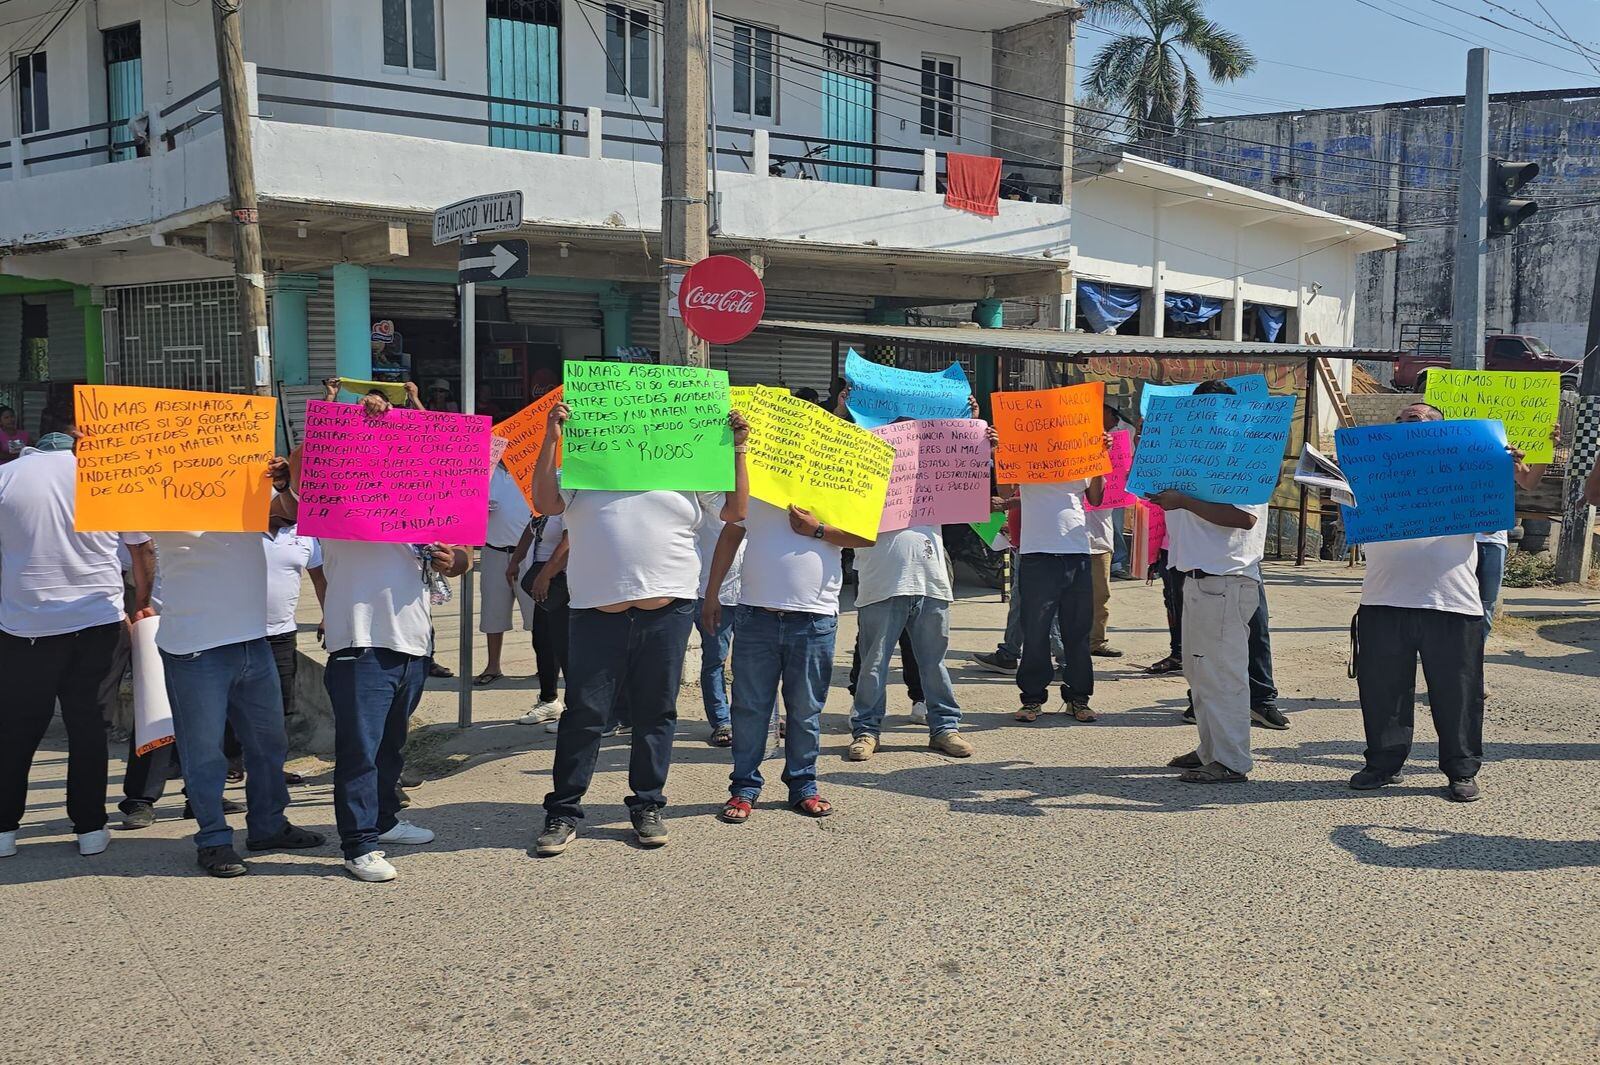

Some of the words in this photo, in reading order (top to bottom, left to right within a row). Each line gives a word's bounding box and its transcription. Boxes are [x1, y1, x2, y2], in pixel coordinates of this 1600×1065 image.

[437, 205, 478, 237] FRANCISCO
[482, 200, 514, 224] VILLA
[567, 364, 584, 378] NO
[589, 365, 621, 378] MAS
[567, 380, 631, 392] INOCENTES
[635, 381, 646, 390] SI
[668, 380, 710, 389] GUERRA
[713, 381, 725, 389] ES
[1429, 372, 1493, 387] EXIGIMOS
[1499, 375, 1517, 389] TU
[566, 396, 608, 407] ENTRE
[614, 393, 667, 407] USTEDES
[674, 391, 727, 402] ACABENSE
[756, 386, 773, 399] LOS
[1478, 392, 1516, 407] NARCO
[114, 402, 147, 417] MAS
[154, 399, 233, 412] ASESINATOS
[244, 399, 253, 411] A
[308, 403, 328, 414] LOS
[1222, 397, 1244, 409] DEL
[623, 410, 628, 422] Y
[631, 410, 646, 419] NO
[650, 406, 687, 417] MATEN
[695, 404, 720, 415] MAS
[1146, 412, 1174, 423] ORTE
[1187, 411, 1218, 422] EXIGE
[1225, 412, 1237, 422] LA
[1487, 407, 1525, 421] ESTAS
[80, 419, 150, 436] INOCENTES
[157, 418, 169, 428] SI
[254, 411, 270, 420] ES
[307, 416, 359, 427] CONTRAS
[1014, 412, 1091, 432] GOBERNADORA
[79, 437, 125, 451] ENTRE
[130, 429, 189, 445] USTEDES
[197, 421, 261, 435] ACABENSE
[306, 430, 354, 440] CONTRAS
[380, 433, 399, 441] LOS
[450, 434, 470, 442] LOS
[565, 424, 636, 438] INDEFENSOS
[644, 420, 683, 436] PSEUDO
[1171, 425, 1185, 435] DE
[1191, 425, 1203, 435] LA
[1209, 425, 1240, 438] NARCO
[765, 432, 801, 448] COBRAN
[1368, 432, 1393, 443] MAS
[78, 451, 140, 468] USTEDES
[145, 449, 152, 459] Y
[157, 446, 175, 456] NO
[180, 436, 224, 452] MATEN
[231, 434, 259, 445] MAS
[459, 443, 479, 453] LOS
[567, 442, 586, 453] DE
[591, 440, 621, 451] LOS
[920, 446, 941, 455] ERES
[1169, 439, 1227, 449] PROTECTORA
[1232, 441, 1245, 453] DE
[1254, 444, 1275, 454] LOS
[469, 457, 482, 466] NO
[752, 459, 793, 478] ESTATAL
[1175, 455, 1220, 467] SICARIOS
[1226, 456, 1240, 467] DE
[1245, 459, 1267, 470] LOS
[80, 462, 162, 482] INDEFENSOS
[174, 457, 223, 472] PSEUDO
[304, 469, 326, 478] NOS
[1051, 469, 1065, 478] TU
[1170, 466, 1198, 477] TODOS
[1203, 470, 1253, 481] SABEMOS
[91, 486, 112, 497] DE
[117, 481, 144, 494] LOS
[1129, 481, 1145, 490] LOS
[1210, 482, 1250, 495] TORITA
[399, 493, 412, 502] LO
[428, 505, 435, 515] Y
